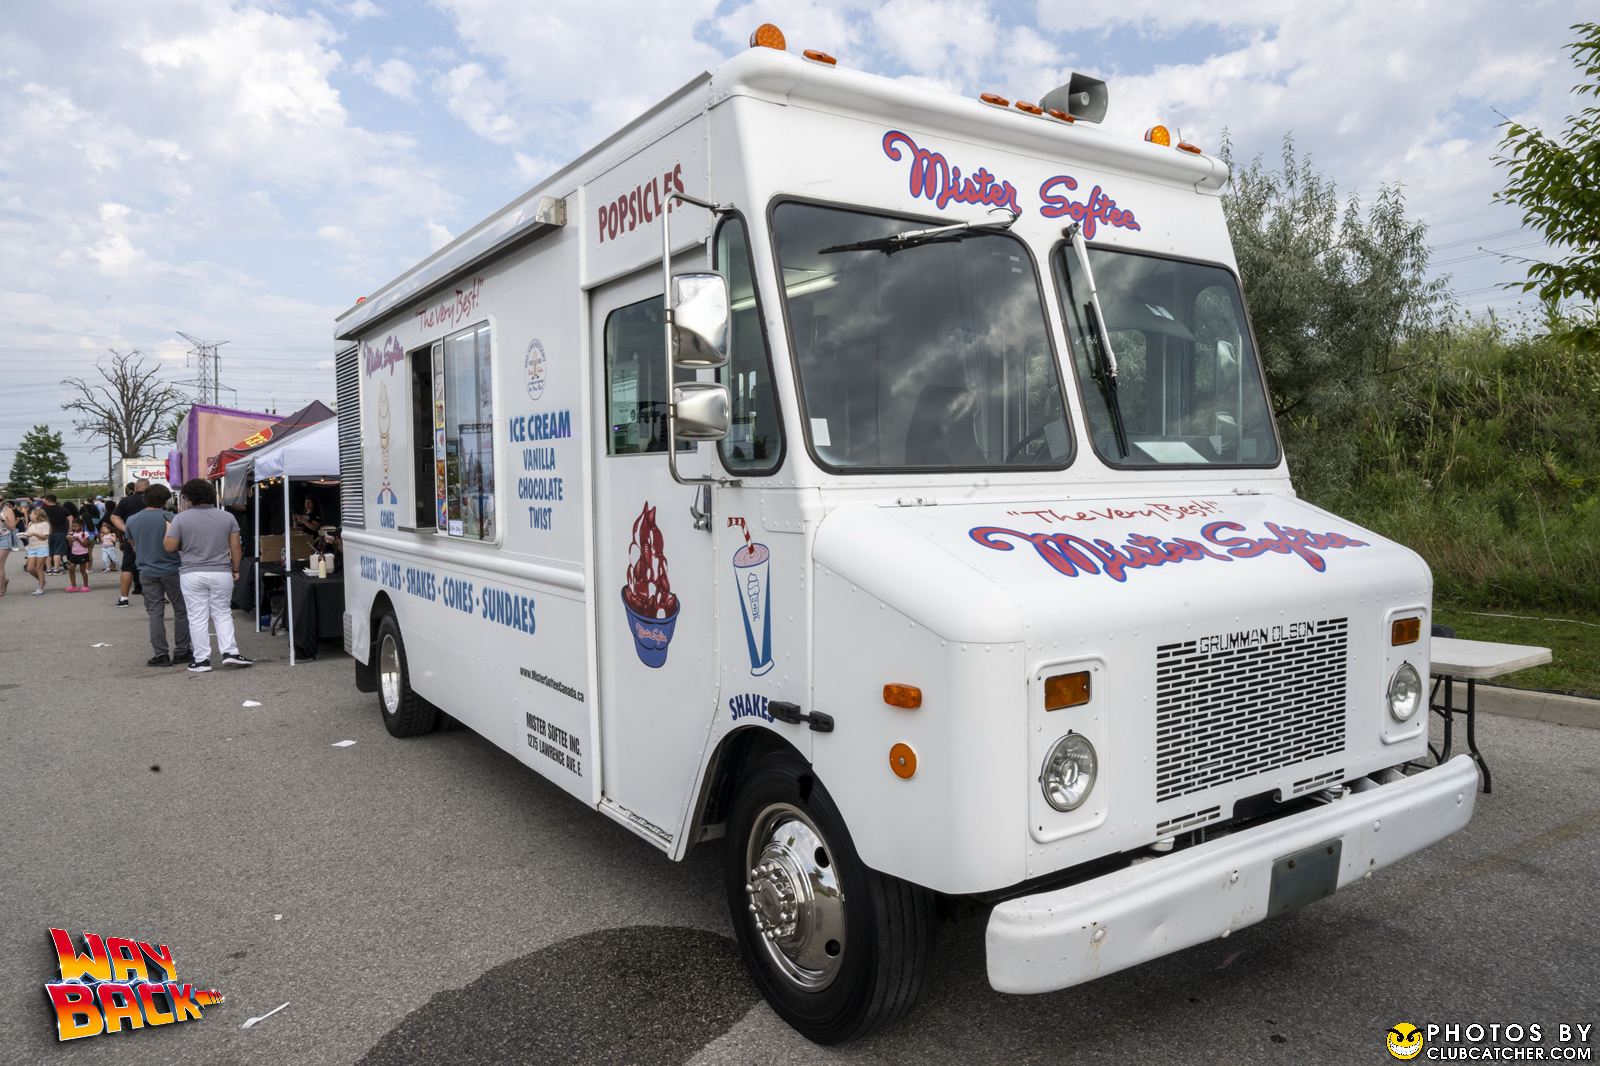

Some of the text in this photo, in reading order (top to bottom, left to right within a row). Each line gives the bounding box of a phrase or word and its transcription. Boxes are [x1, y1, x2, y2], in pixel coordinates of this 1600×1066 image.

[598, 163, 685, 243] POPSICLES
[882, 130, 1141, 240] Mister Softee
[509, 410, 571, 443] ICE CREAM
[523, 448, 556, 471] VANILLA
[518, 477, 563, 501] CHOCOLATE
[380, 510, 395, 529] CONES
[528, 507, 552, 530] TWIST
[968, 521, 1371, 583] Mister Softee
[360, 555, 537, 636] SLUSH SPLITS SHAKES CONES SUNDAES
[1200, 620, 1315, 654] GRUMMAN OLSON
[519, 666, 585, 703] www.MisterSofteeCanada.ca
[526, 711, 582, 757] MISTER SOFTEE INC.
[527, 733, 583, 777] 1275 LAWRENCE AVE. E.
